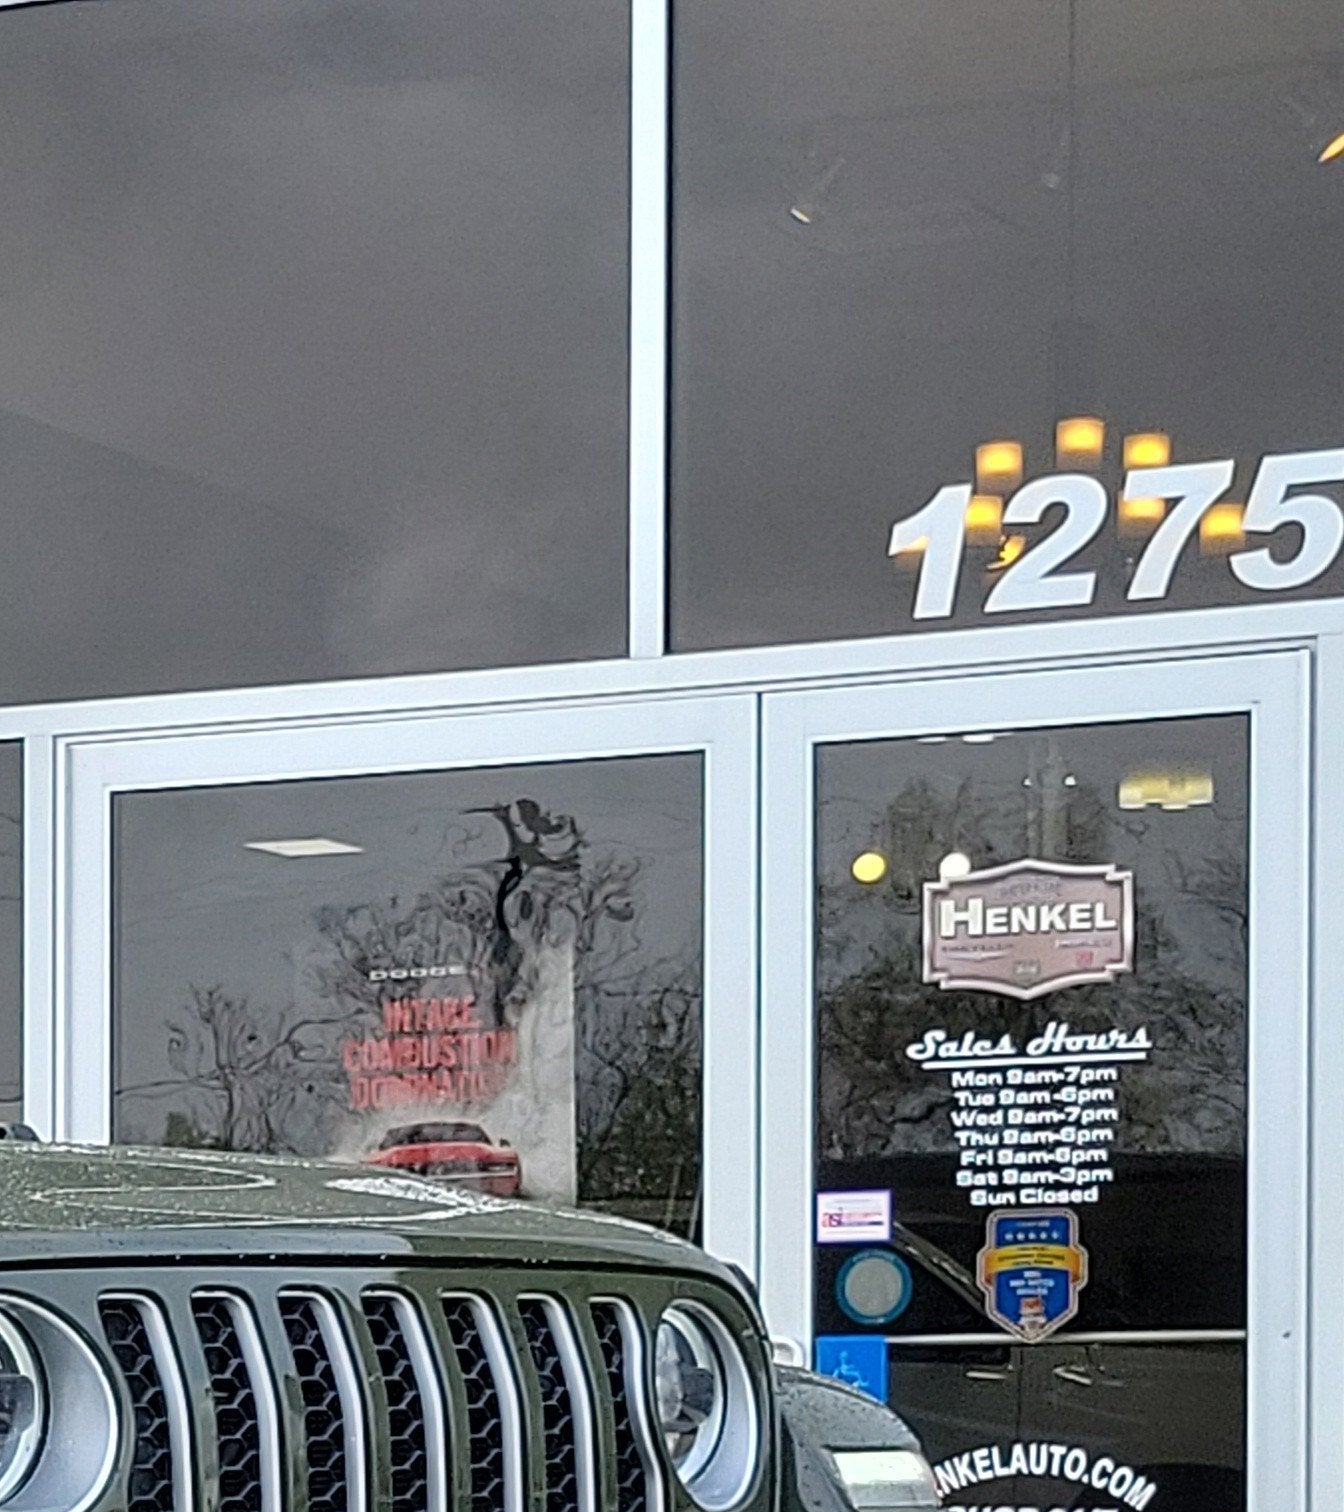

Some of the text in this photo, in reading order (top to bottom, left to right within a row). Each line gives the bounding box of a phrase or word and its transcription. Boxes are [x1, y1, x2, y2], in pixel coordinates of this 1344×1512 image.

[888, 449, 1344, 620] 1275
[940, 898, 1118, 938] HENKEL
[370, 966, 467, 980] DODGE
[906, 1021, 1152, 1060] Sales Hours
[951, 1071, 1002, 1088] Mon
[954, 1090, 995, 1107] Tue
[951, 1109, 1002, 1126] Wed
[954, 1130, 999, 1146] Thu
[961, 1150, 994, 1166] Fri
[956, 1170, 998, 1186] Sat
[970, 1185, 1099, 1206] Sun Closed
[935, 1442, 1157, 1512] NKELAUTO.COM
